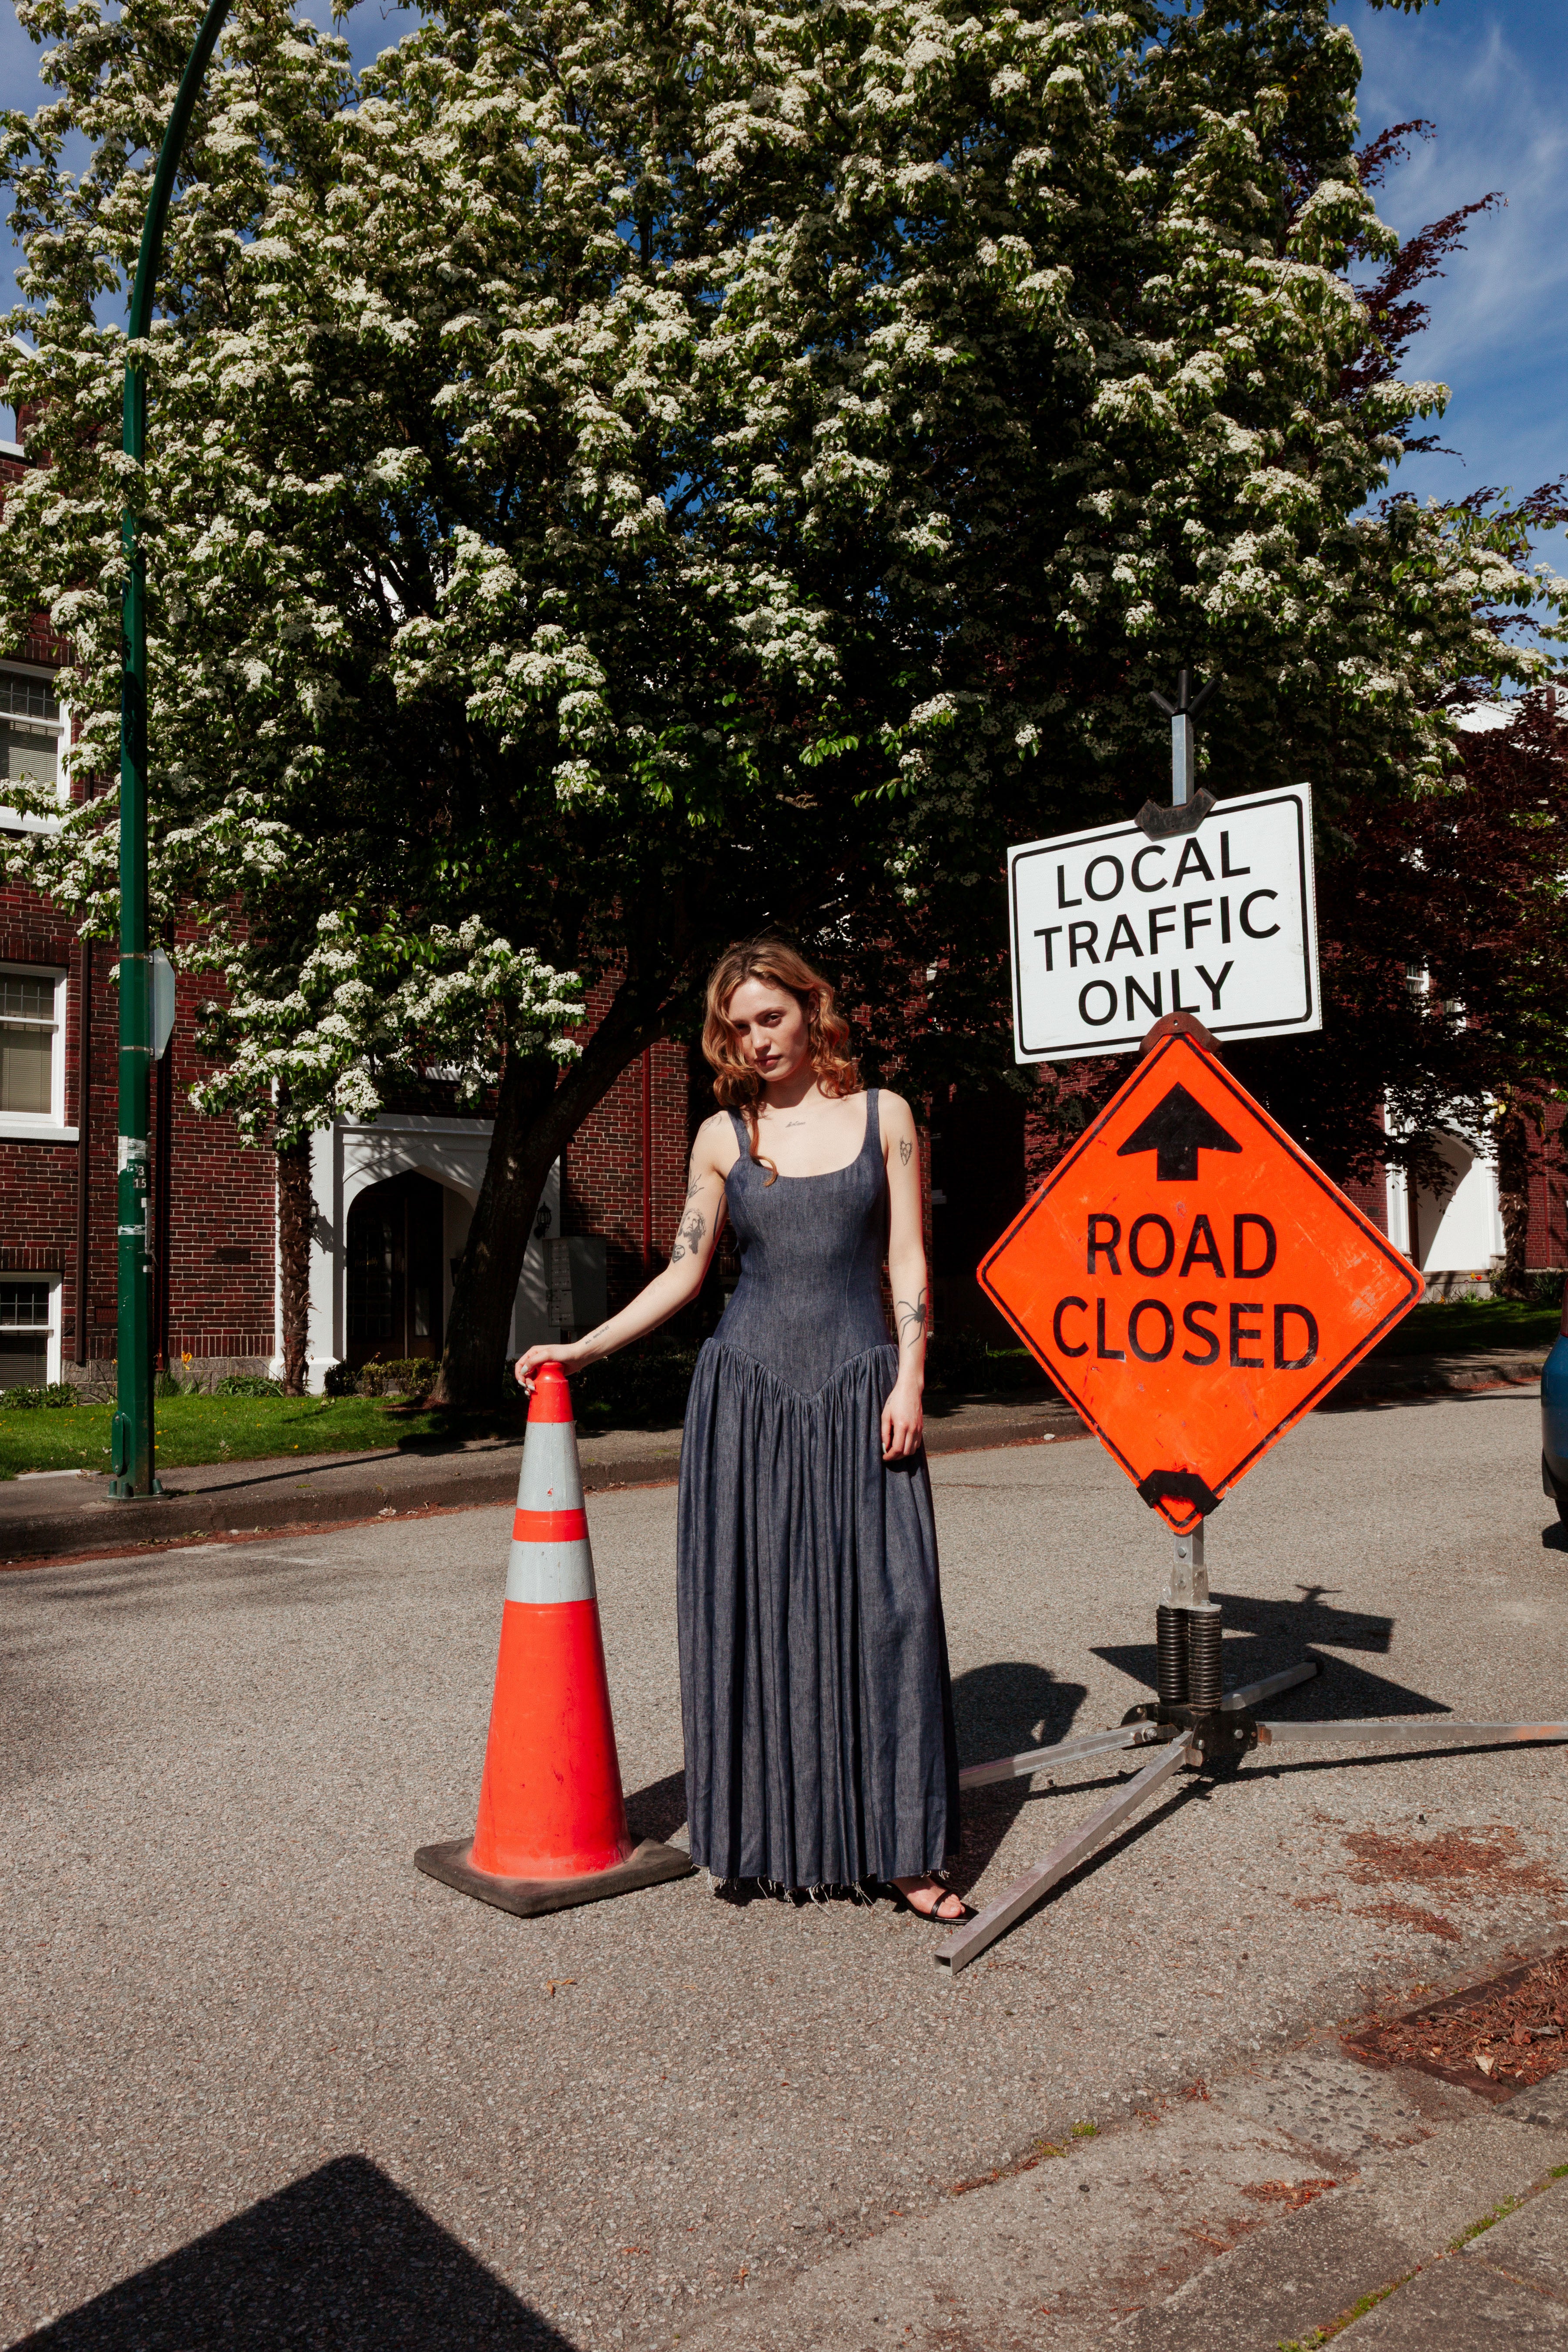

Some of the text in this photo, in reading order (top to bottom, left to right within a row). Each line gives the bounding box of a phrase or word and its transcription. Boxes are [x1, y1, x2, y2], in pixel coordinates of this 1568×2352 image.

[1057, 830, 1250, 909] LOCAL
[1034, 889, 1281, 972] TRAFFIC
[1078, 960, 1234, 1026] ONLY
[135, 1179, 146, 1188] 15
[1087, 1213, 1277, 1278] ROAD
[1053, 1296, 1318, 1370] CLOSED
